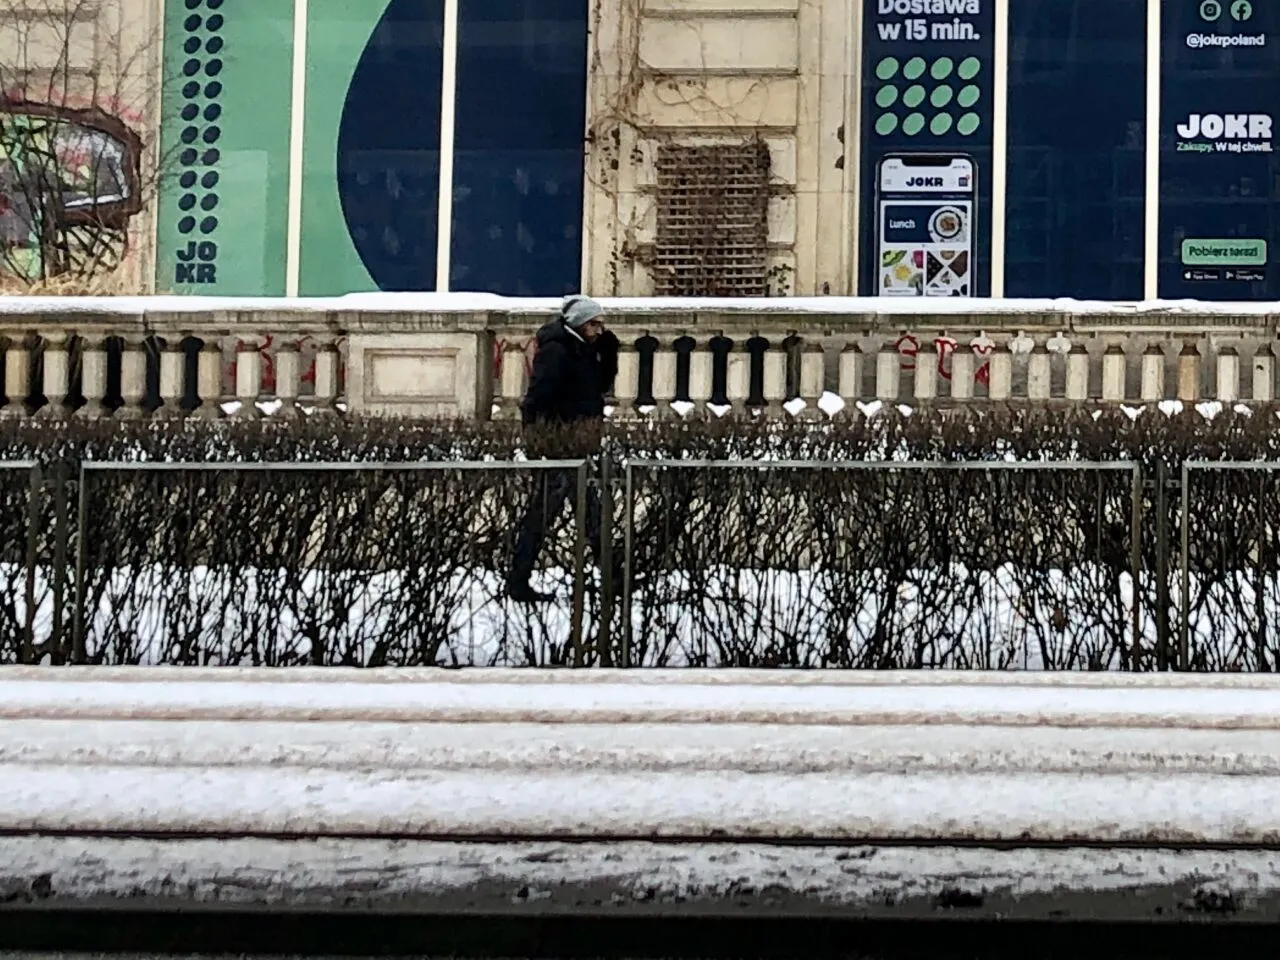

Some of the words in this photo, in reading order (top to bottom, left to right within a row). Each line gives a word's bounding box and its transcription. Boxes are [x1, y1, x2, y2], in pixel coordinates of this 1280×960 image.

[877, 22, 902, 40] w
[904, 18, 928, 40] 15
[931, 17, 981, 40] min.
[1186, 33, 1265, 48] @jokrpoland
[1176, 113, 1273, 139] JOKR
[1215, 141, 1227, 152] W
[905, 176, 944, 187] JOKR
[889, 219, 916, 229] Lunch
[176, 240, 217, 262] JO
[1188, 246, 1228, 257] Pobierz
[175, 263, 217, 284] KR
